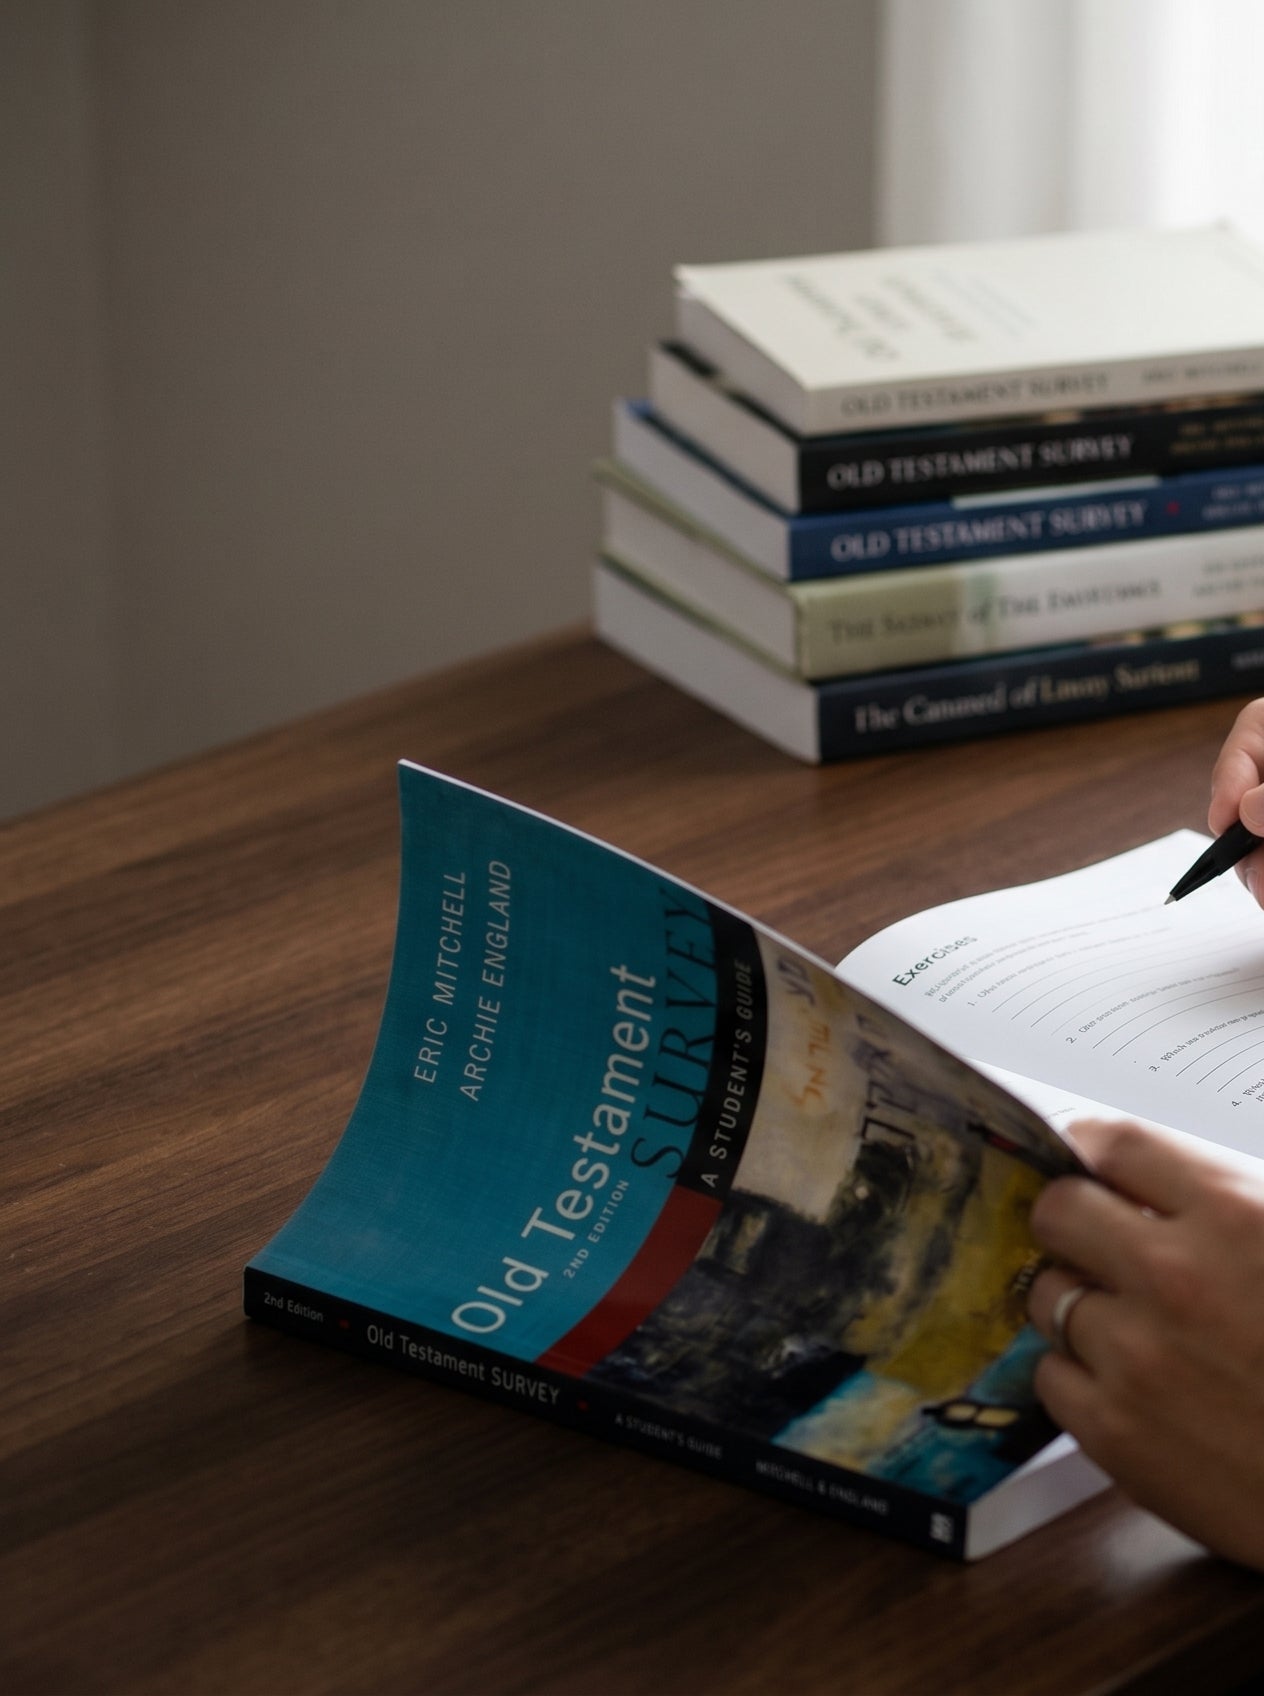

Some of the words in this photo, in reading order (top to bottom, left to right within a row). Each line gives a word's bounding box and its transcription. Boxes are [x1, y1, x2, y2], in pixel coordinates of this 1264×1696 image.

[826, 459, 885, 491] OLD
[888, 442, 1035, 483] TESTAMENT
[1038, 433, 1133, 467] SURVEY
[830, 531, 891, 563] OLD
[893, 510, 1047, 554] TESTAMENT
[1050, 500, 1148, 536] SURVEY
[855, 703, 897, 733] The
[414, 1018, 447, 1083] ERIC
[433, 872, 466, 1005] MITCHELL
[460, 996, 500, 1101] ARCHIE
[482, 860, 511, 987] ENGLAND
[735, 959, 753, 1021] GUIDE
[892, 935, 978, 987] Exercises
[631, 887, 717, 1178] SURVEY
[709, 1030, 752, 1159] STUDENT'S
[451, 1256, 550, 1334] Old
[521, 964, 657, 1241] Testament
[701, 1172, 719, 1188] A
[563, 1249, 589, 1279] 2ND
[588, 1180, 629, 1244] EDITION
[263, 1292, 284, 1309] 2nd
[287, 1300, 324, 1323] Edition
[367, 1324, 394, 1349] Old
[400, 1335, 485, 1382] Testament
[491, 1367, 560, 1405] SURVEY
